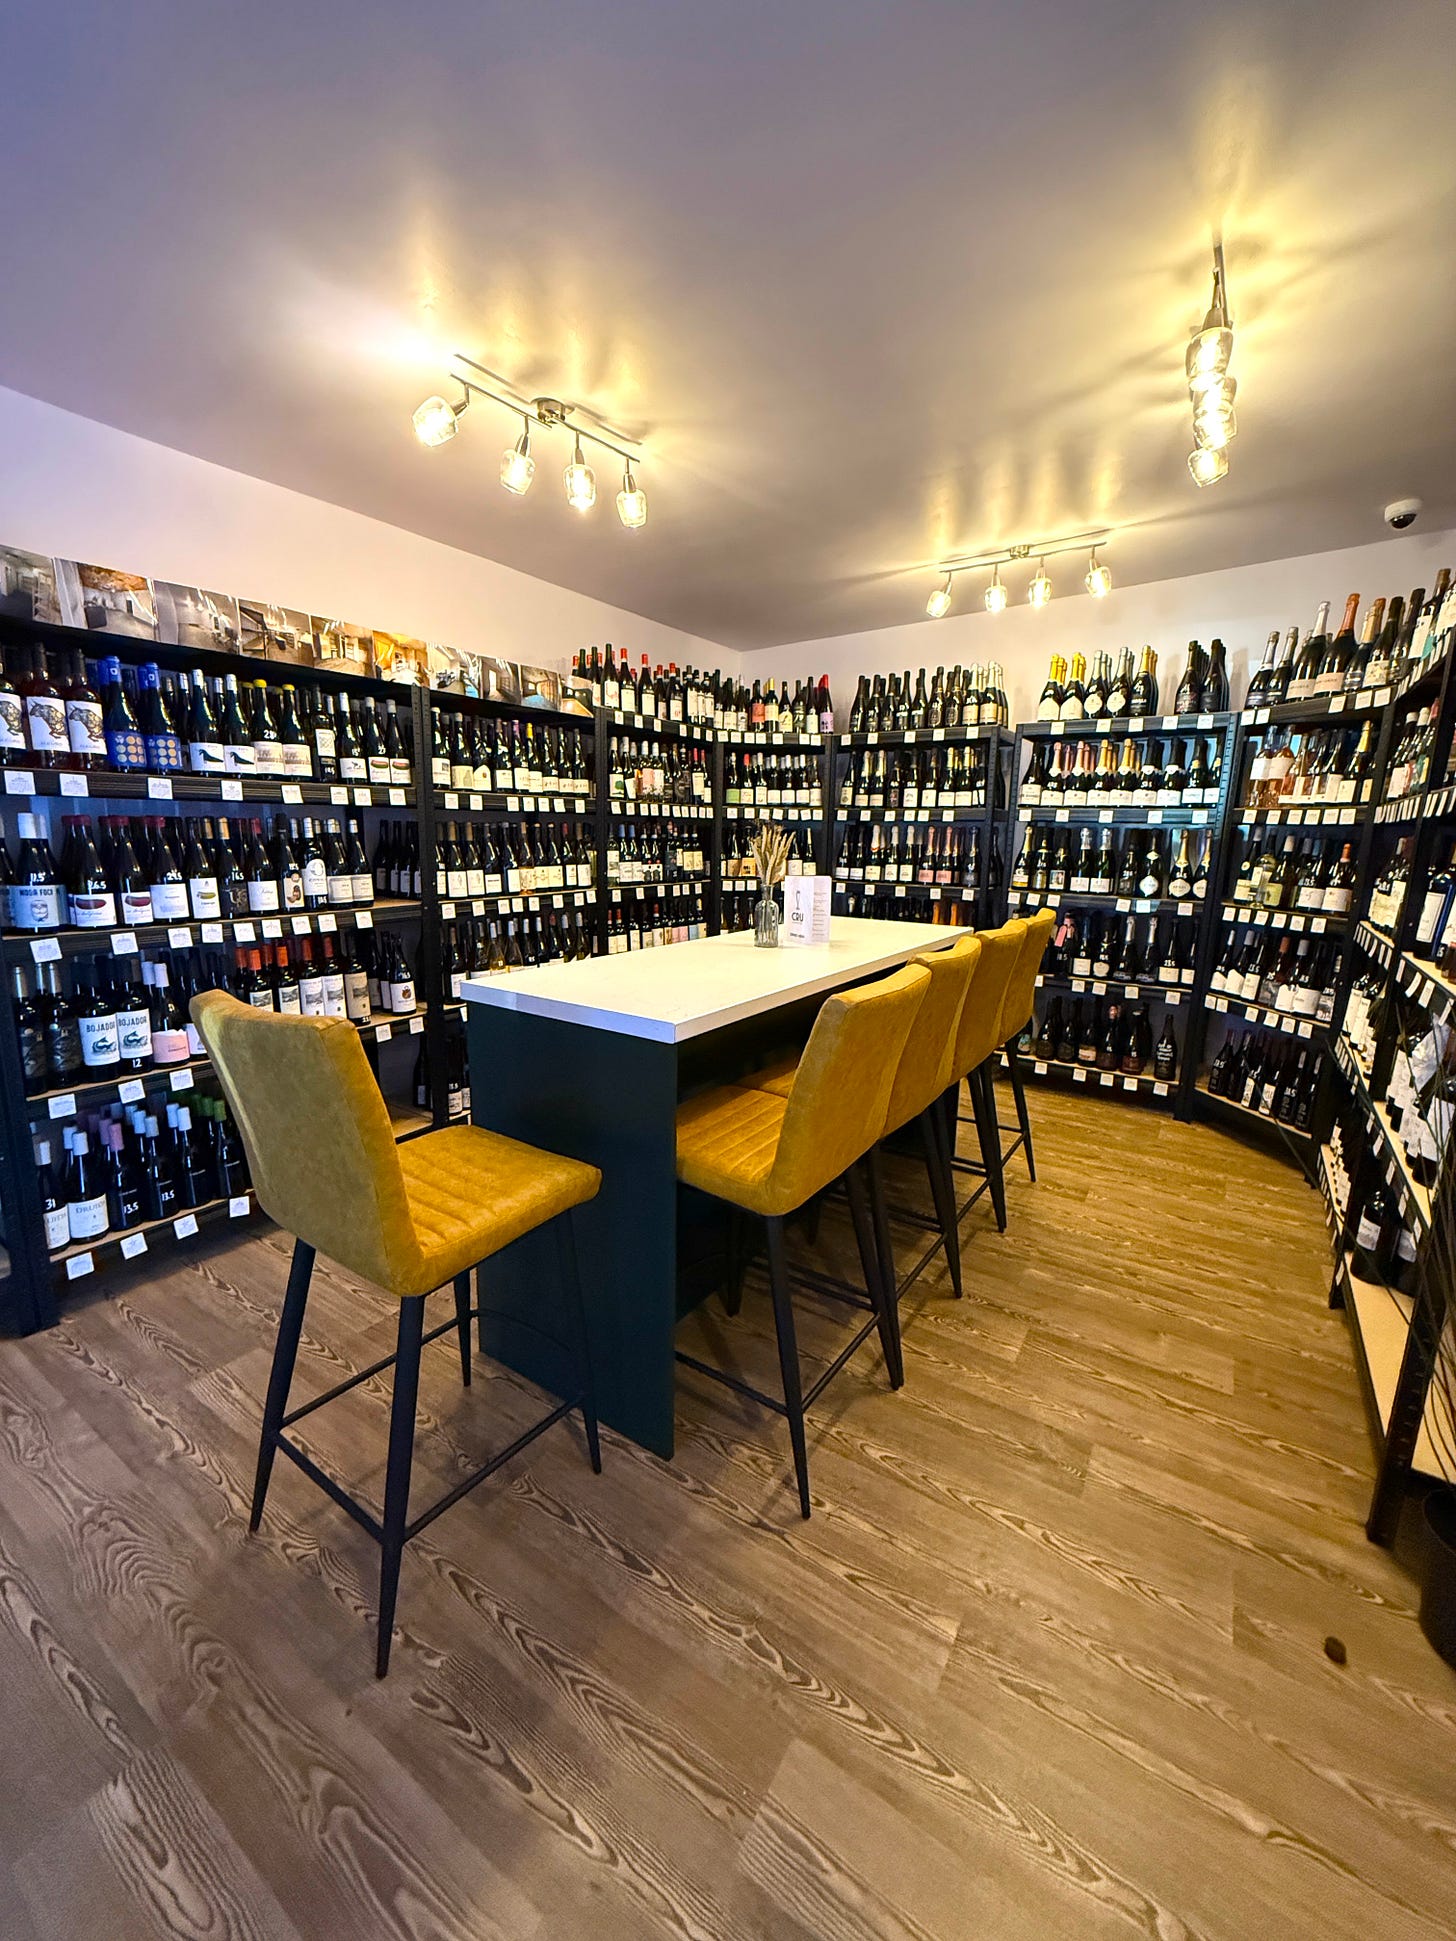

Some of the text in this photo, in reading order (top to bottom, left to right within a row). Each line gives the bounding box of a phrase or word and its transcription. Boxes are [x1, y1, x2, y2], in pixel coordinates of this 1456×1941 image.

[791, 911, 804, 922] CRU
[118, 1015, 147, 1027] BOJADOR
[132, 1059, 143, 1068] 12
[45, 1198, 56, 1210] 31
